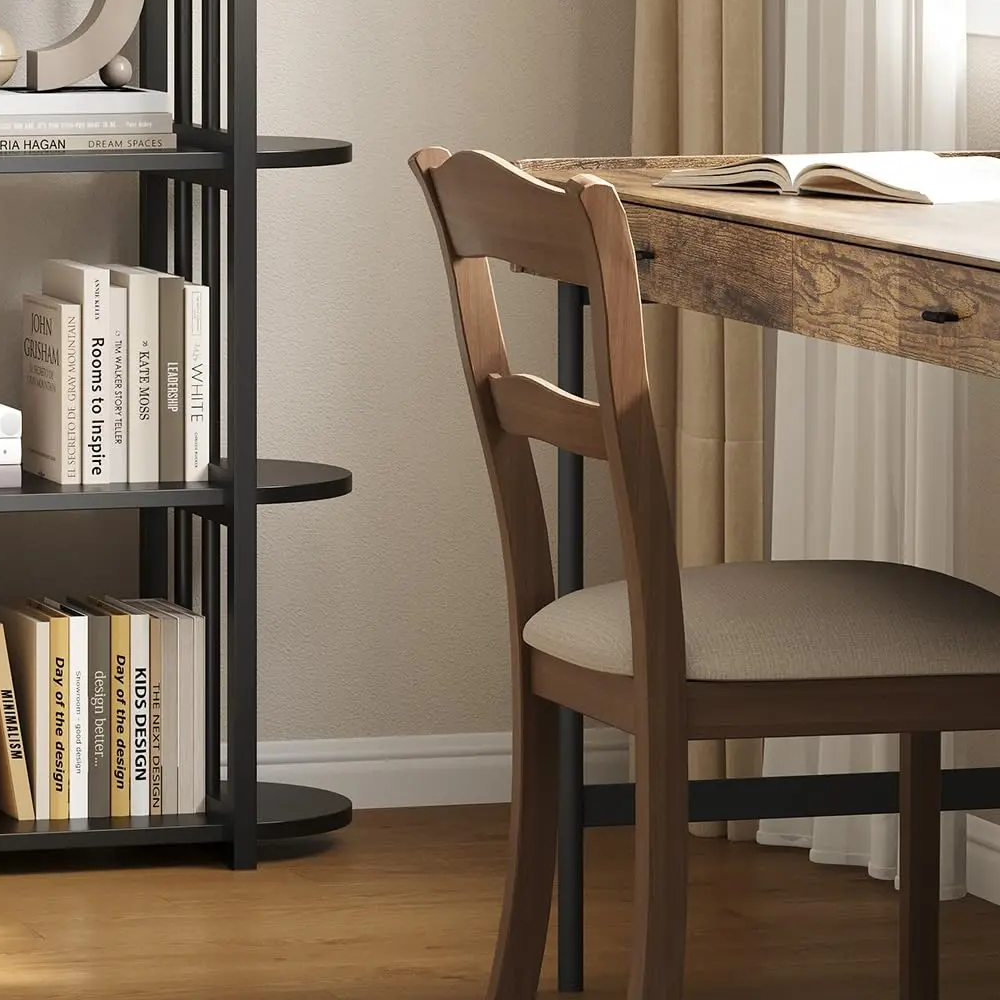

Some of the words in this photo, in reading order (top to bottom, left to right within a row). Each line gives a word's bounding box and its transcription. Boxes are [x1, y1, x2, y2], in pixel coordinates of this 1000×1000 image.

[23, 139, 66, 150] HAGAN
[88, 140, 123, 148] DREAM
[127, 139, 163, 148] SPACES
[31, 312, 52, 336] JOHN
[24, 337, 60, 366] GRISHAM
[68, 316, 76, 373] MOUNTAIN
[92, 337, 105, 391] Rooms
[139, 351, 150, 383] KATE
[68, 375, 76, 402] GRAY
[167, 362, 178, 412] LEADERSHIP
[191, 363, 203, 422] WHITE
[68, 408, 76, 420] DE
[92, 397, 105, 414] to
[139, 387, 150, 420] MOSS
[68, 422, 76, 465] SECRETO
[88, 420, 106, 476] Inspire
[53, 657, 64, 686] Day
[114, 655, 126, 684] Day
[56, 691, 65, 709] of
[90, 670, 106, 714] design
[117, 689, 126, 706] of
[135, 668, 146, 709] KIDS
[1, 689, 23, 760] MINIMALISM
[56, 711, 65, 736] the
[117, 708, 126, 734] the
[94, 718, 106, 767] better...
[135, 714, 146, 781] DESIGN
[53, 741, 65, 792] design
[114, 738, 126, 789] design
